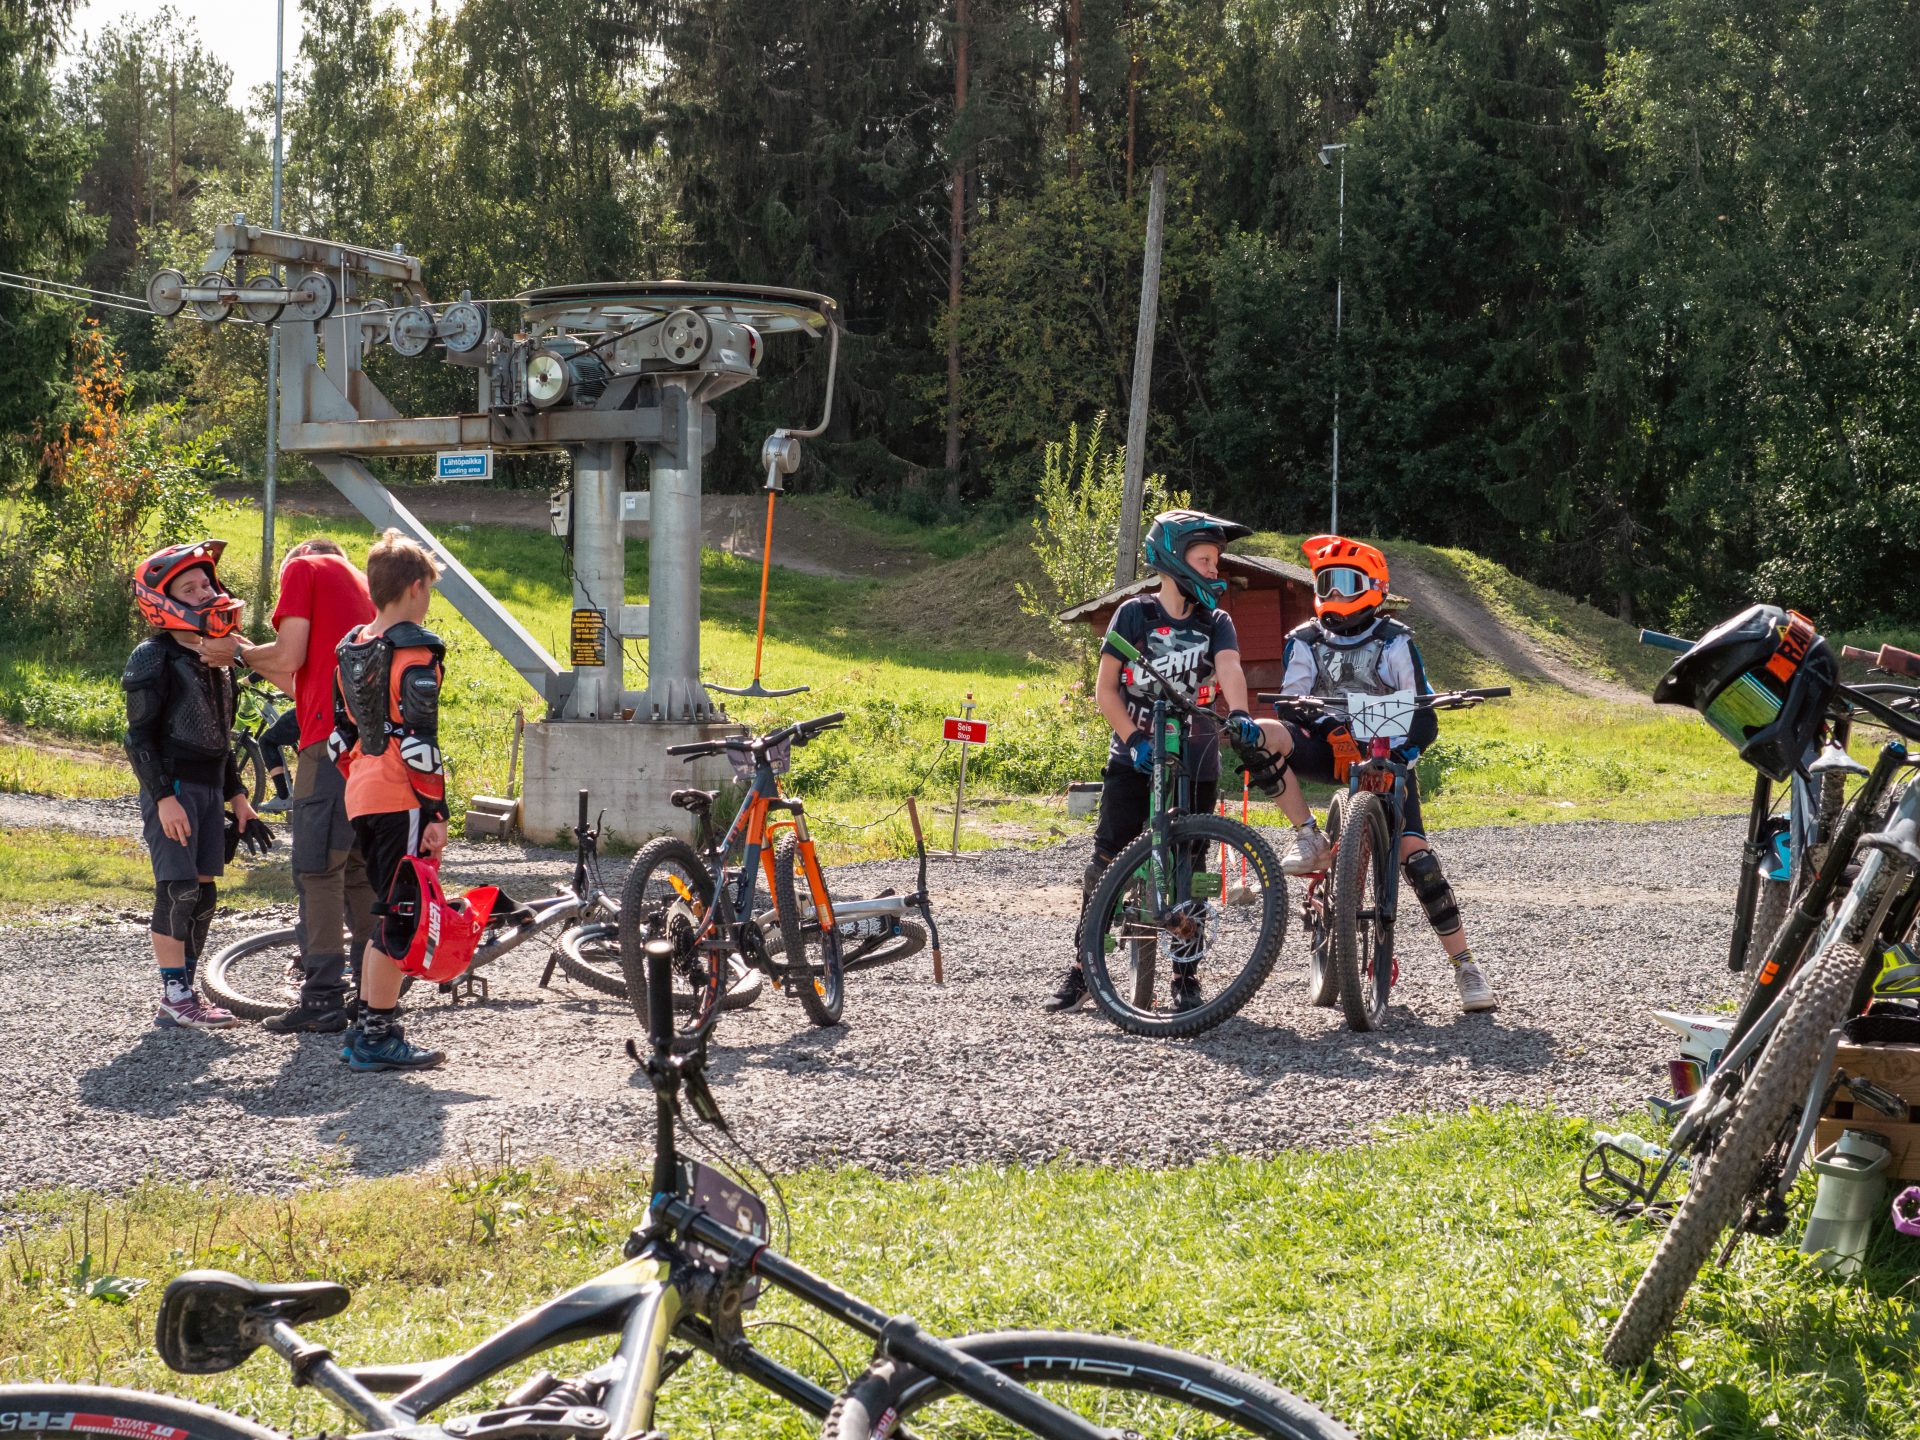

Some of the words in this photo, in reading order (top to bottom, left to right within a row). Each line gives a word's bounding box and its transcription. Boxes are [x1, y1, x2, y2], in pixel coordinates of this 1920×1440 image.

[443, 458, 482, 467] Lähtöpaikka
[957, 722, 972, 732] Seis
[957, 732, 971, 740] Stop
[1243, 842, 1270, 888] MAXXIS
[427, 901, 441, 946] LEATT
[1691, 1023, 1713, 1032] LEATT
[112, 1416, 151, 1432] SWISS
[151, 1424, 175, 1437] DT
